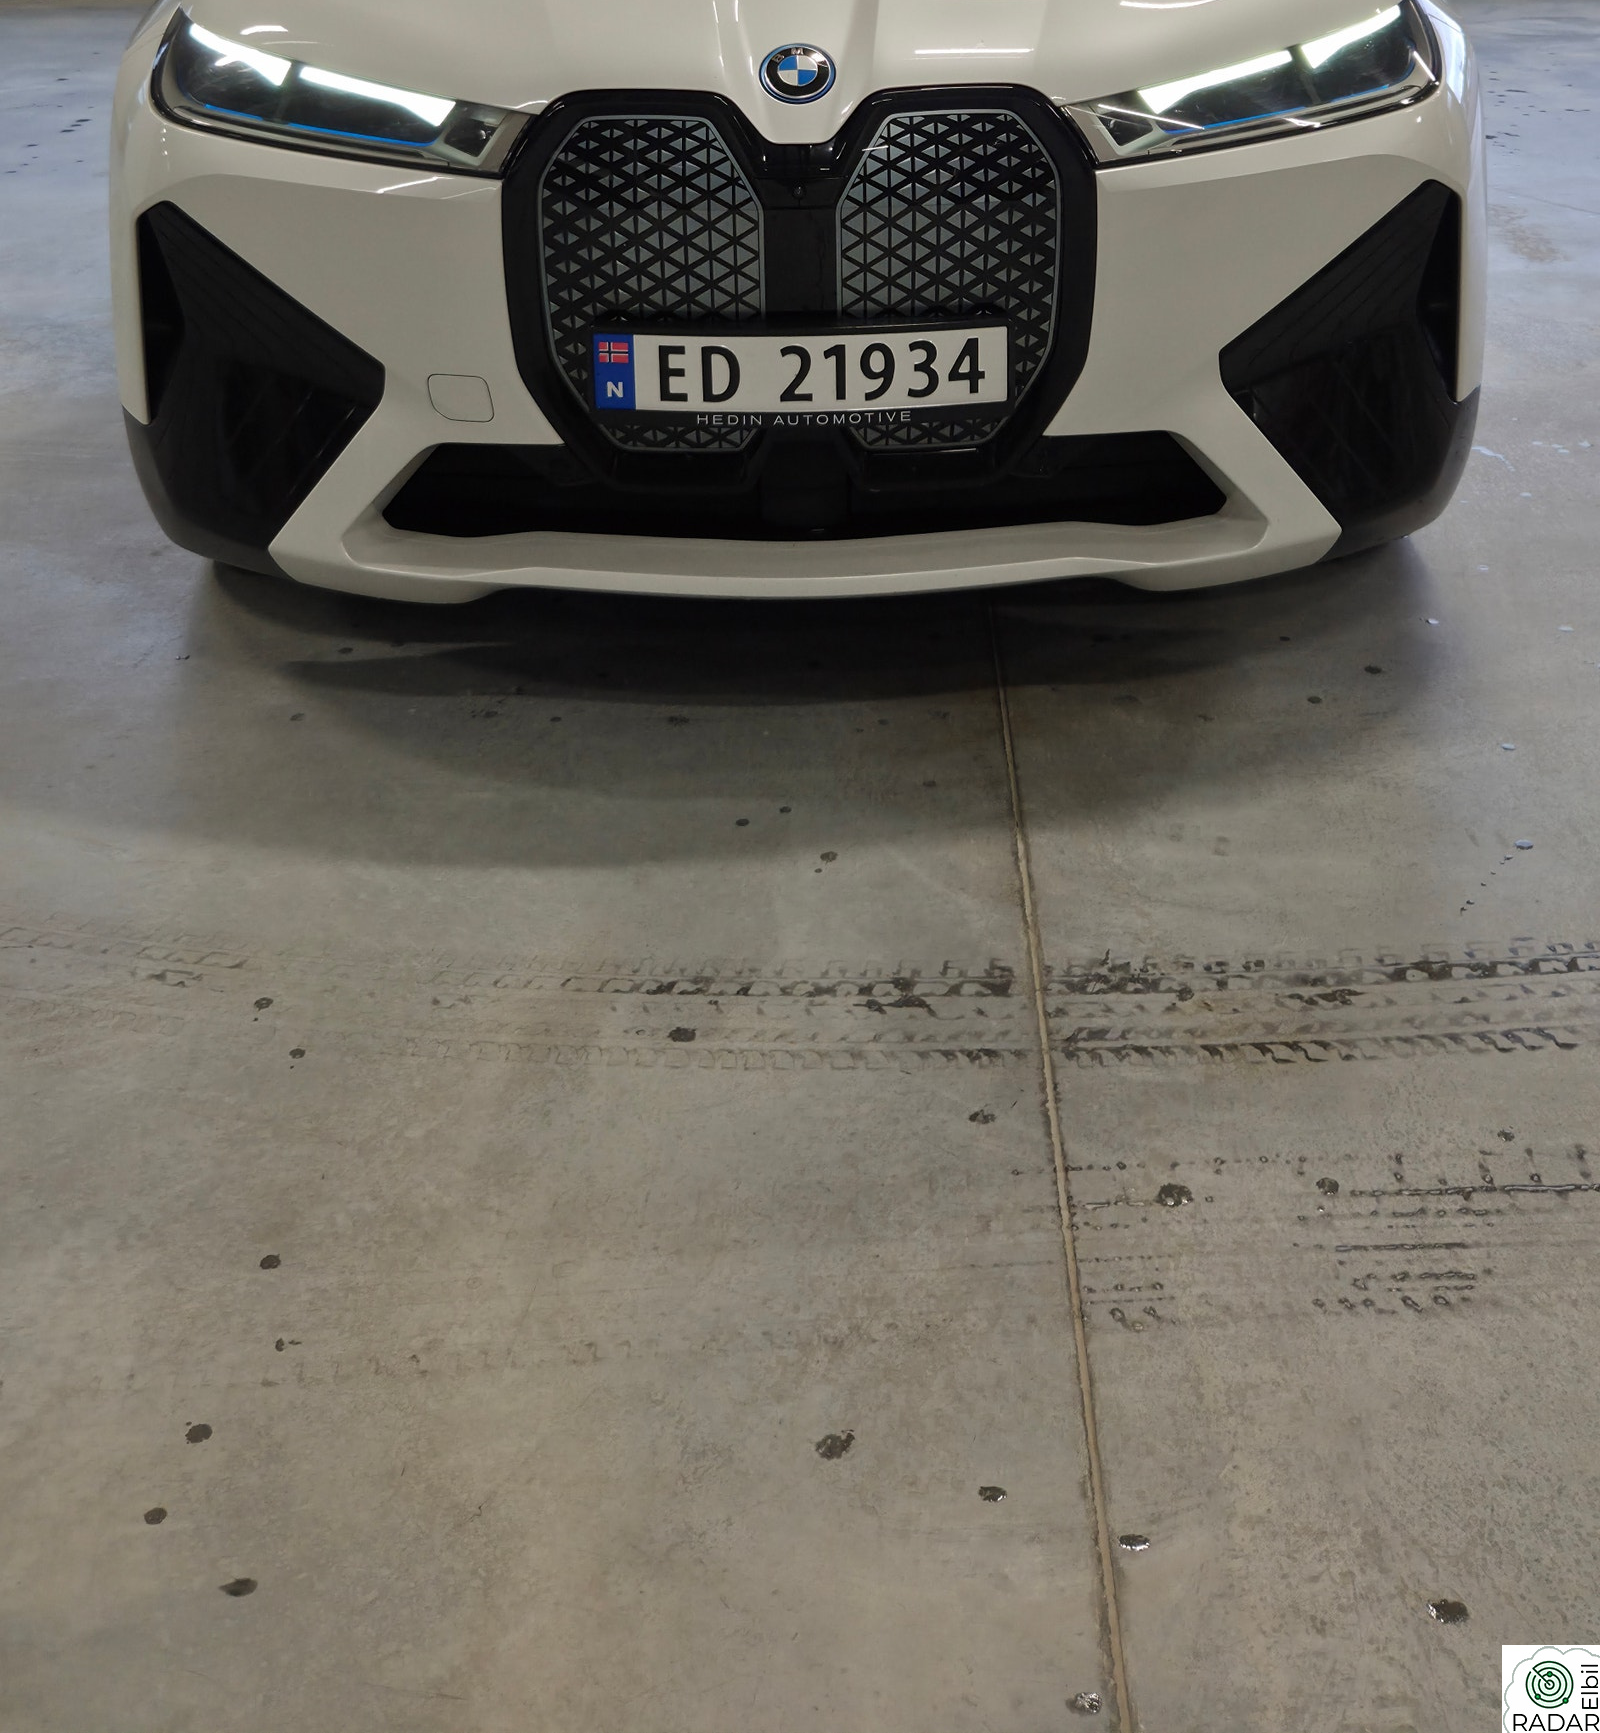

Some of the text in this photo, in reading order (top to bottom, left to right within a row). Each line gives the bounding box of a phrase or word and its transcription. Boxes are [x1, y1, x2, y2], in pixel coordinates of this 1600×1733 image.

[659, 337, 986, 402] ED 21934
[606, 381, 624, 398] N
[697, 411, 912, 426] HEDIN AUTOMOTIVE
